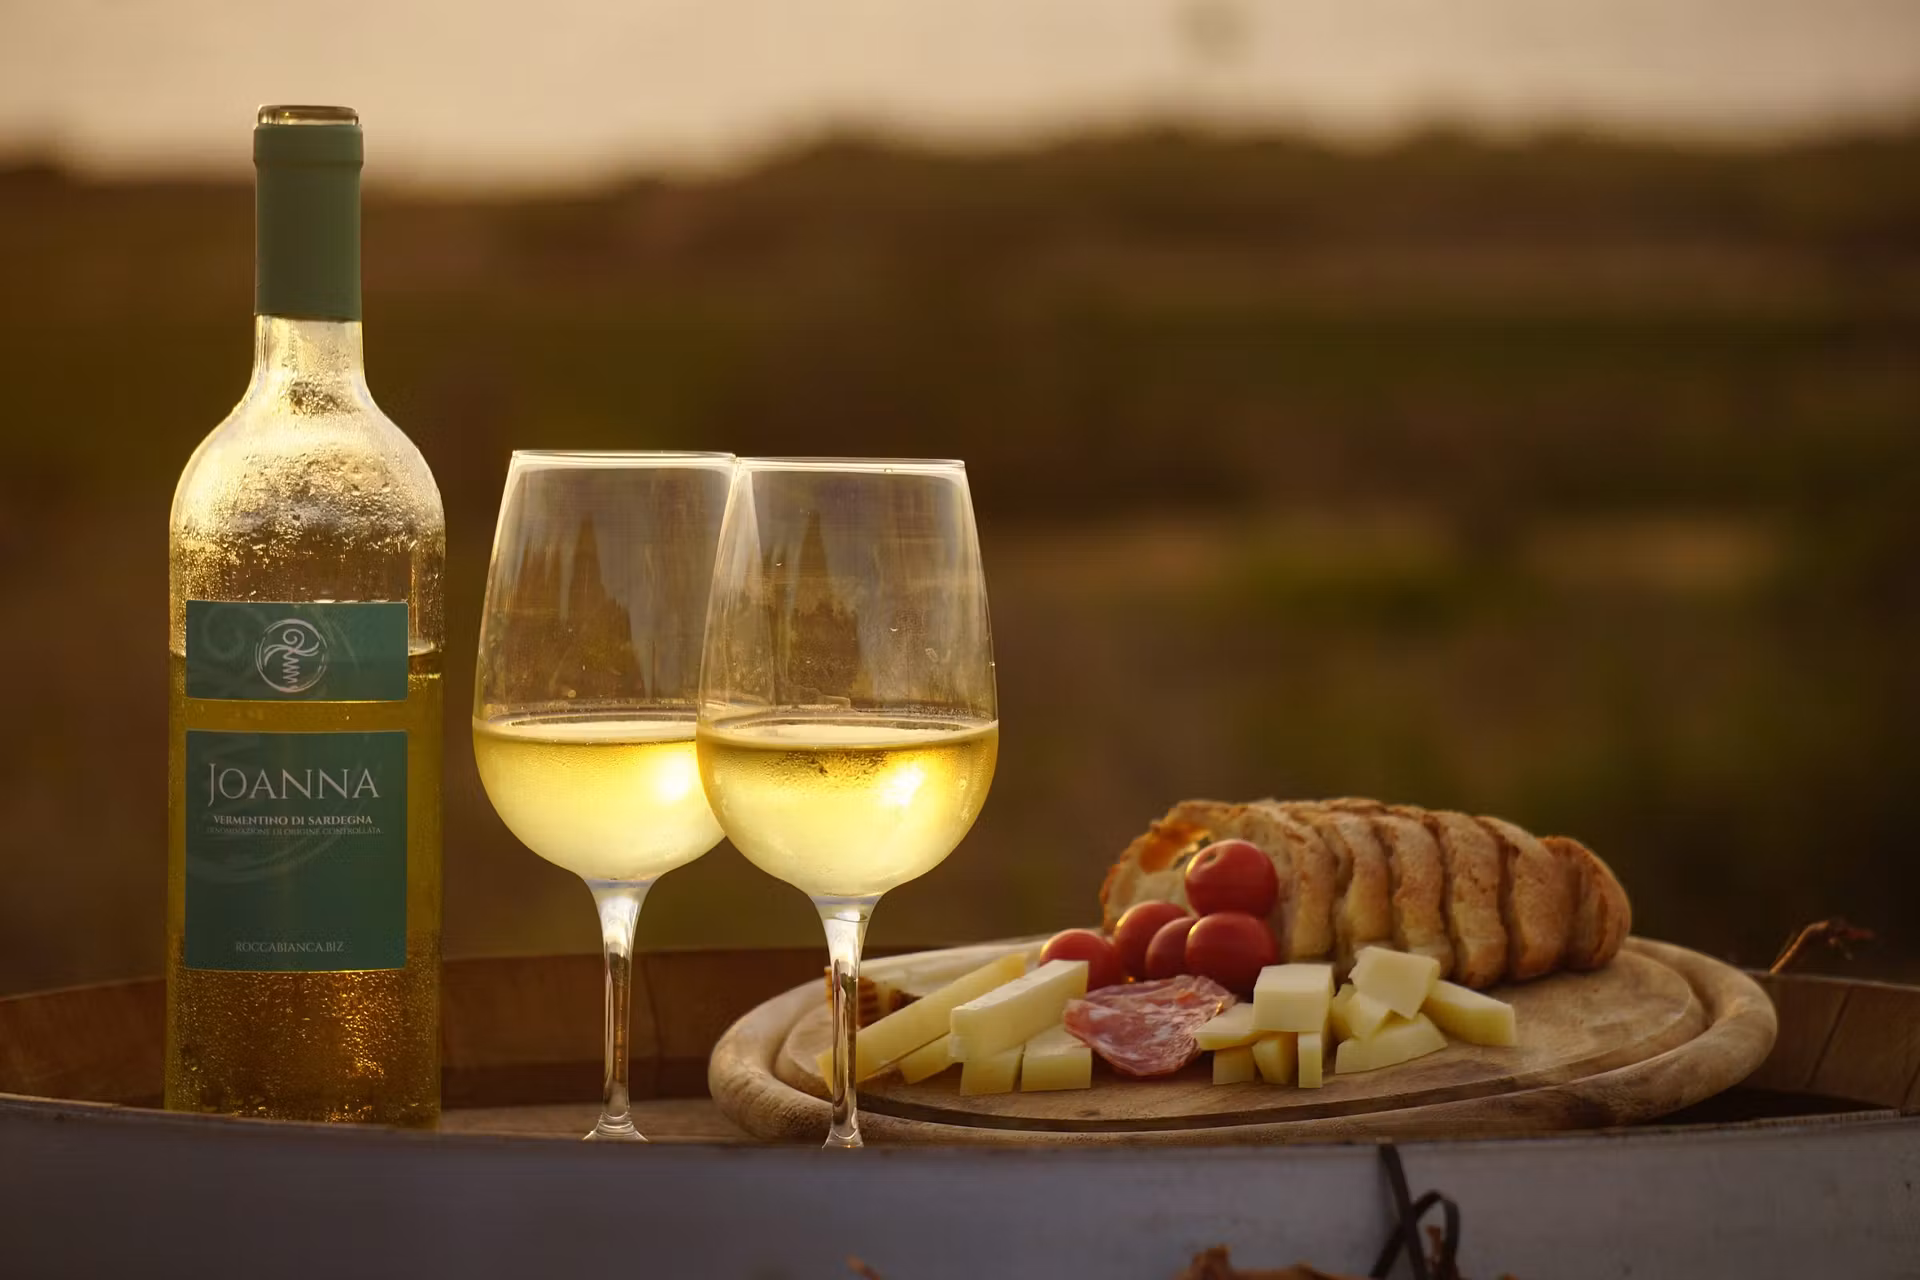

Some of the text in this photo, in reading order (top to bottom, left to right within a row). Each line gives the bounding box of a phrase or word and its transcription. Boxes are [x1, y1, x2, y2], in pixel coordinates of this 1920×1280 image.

[208, 763, 380, 807] JOANNA
[213, 815, 373, 826] VERMENTINO DI SARDEGNA
[235, 941, 345, 953] ROCCABIANCA.BIZ
